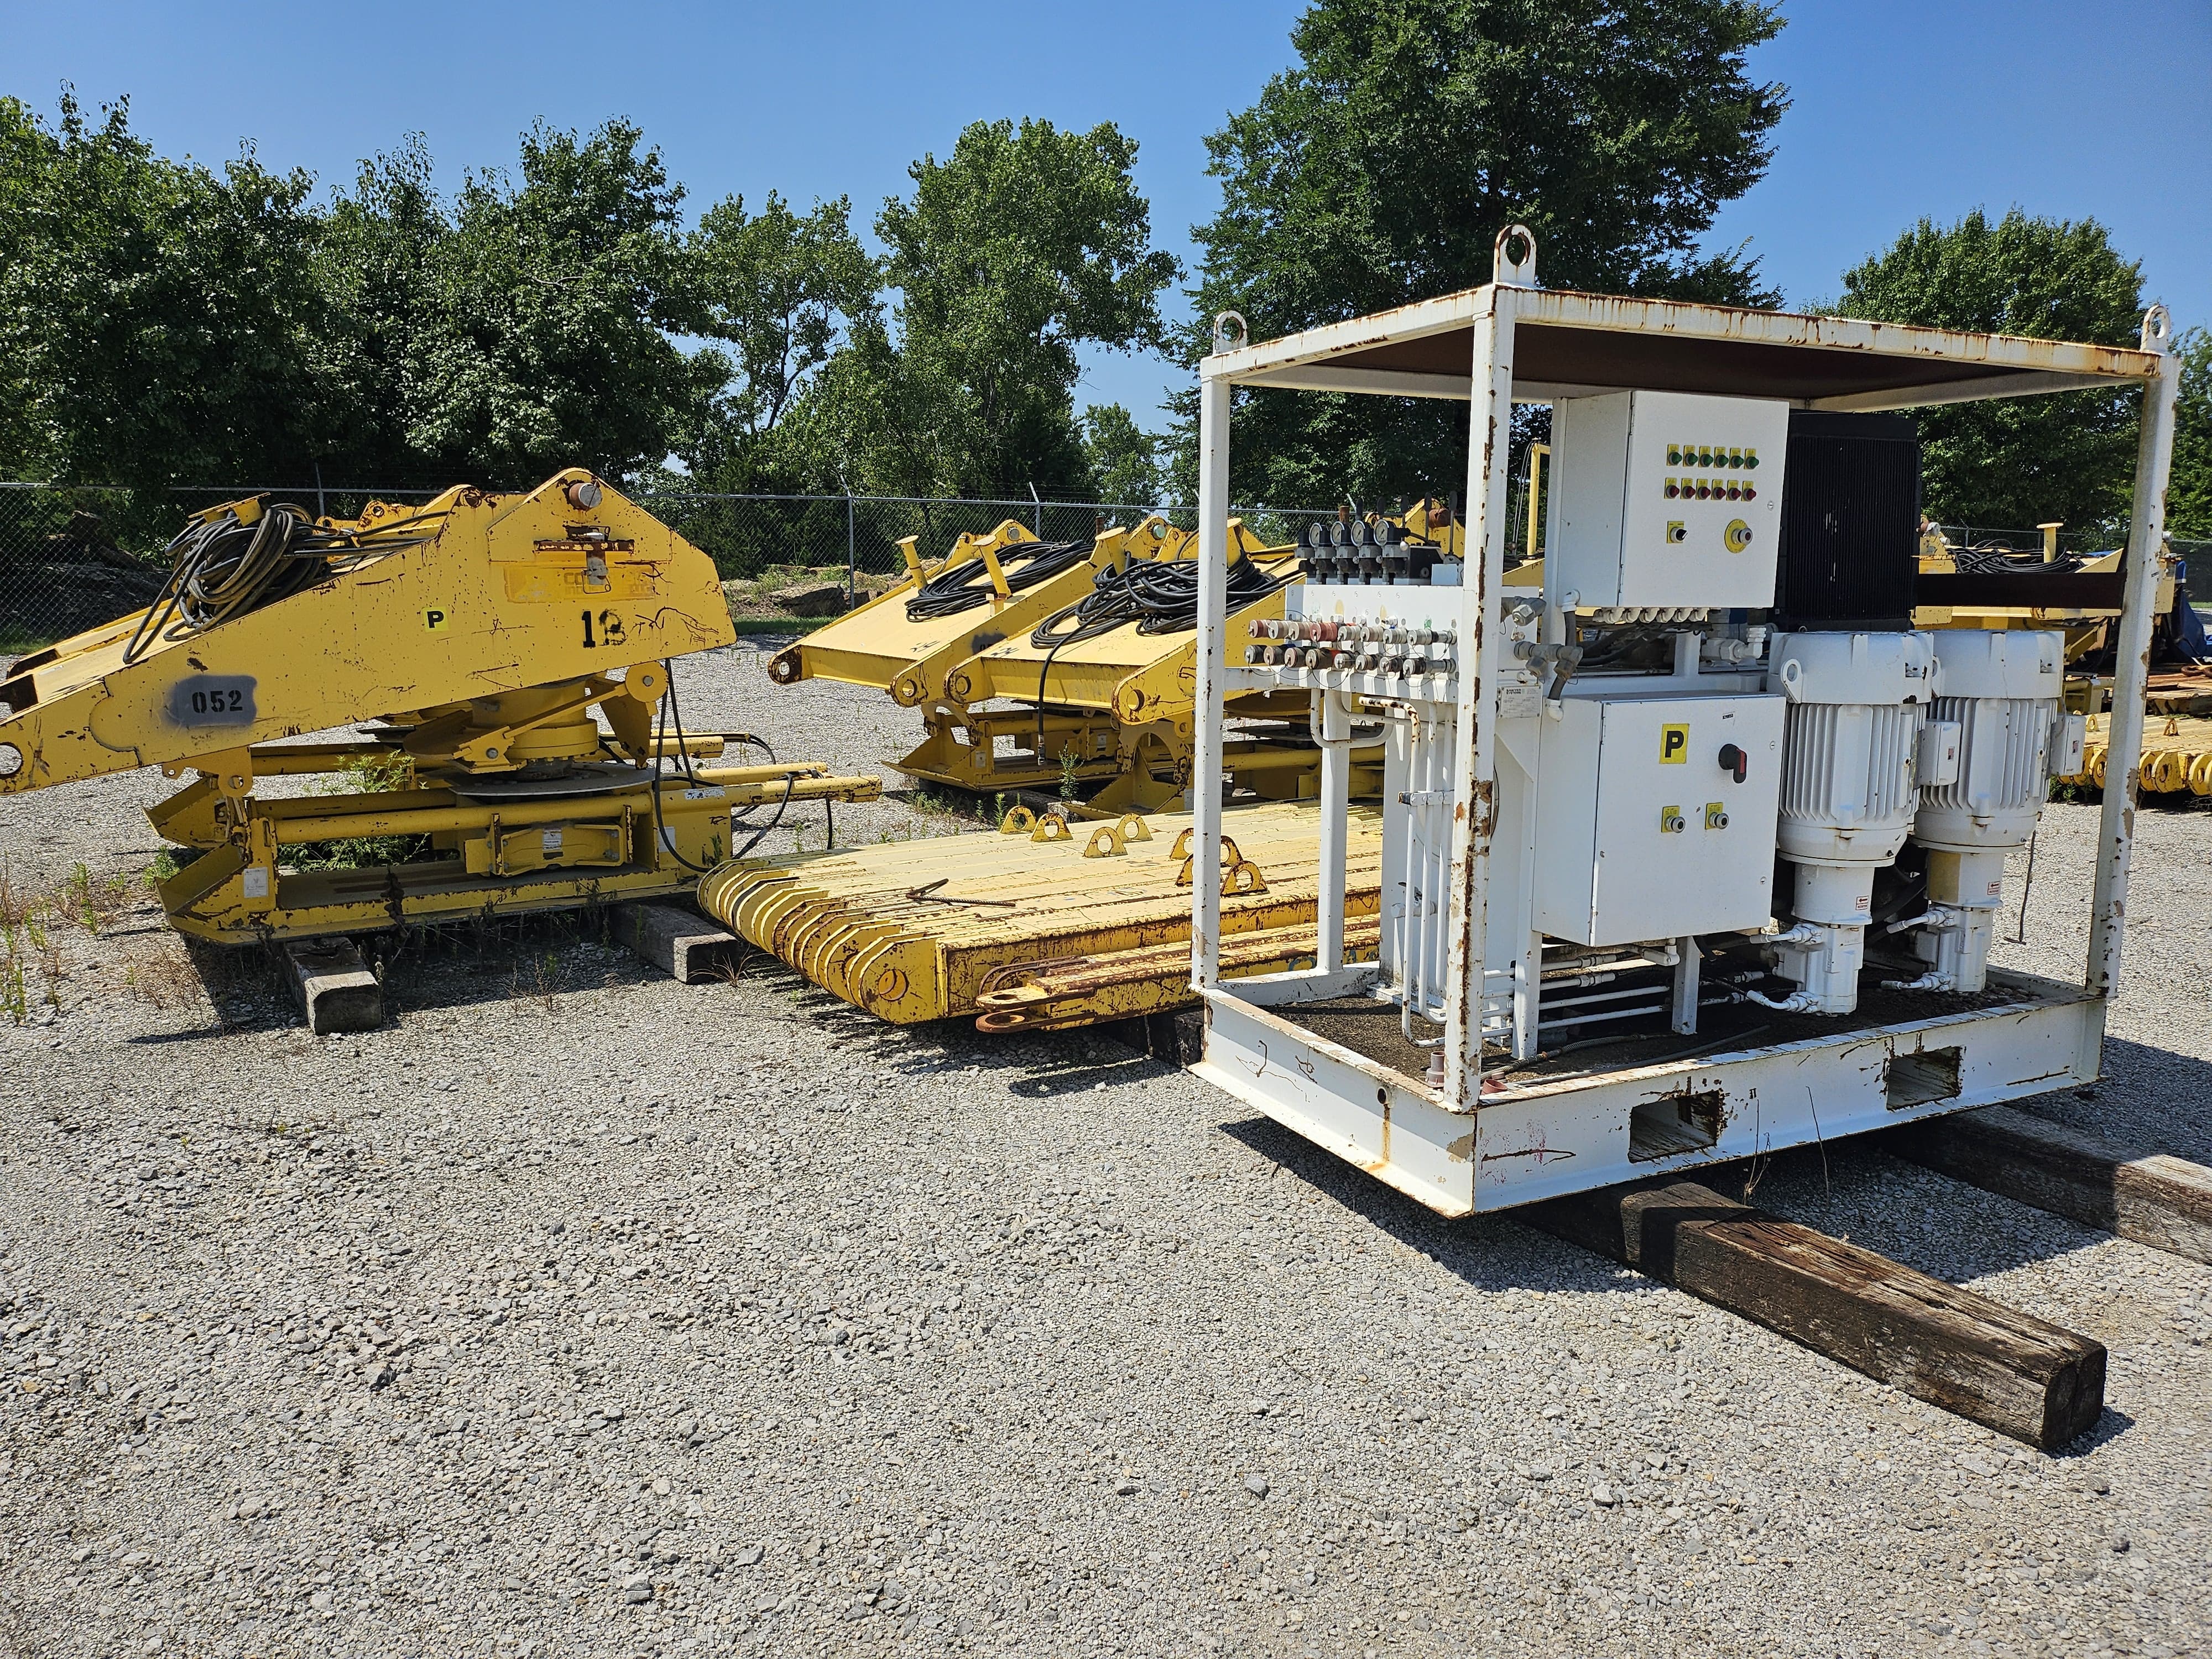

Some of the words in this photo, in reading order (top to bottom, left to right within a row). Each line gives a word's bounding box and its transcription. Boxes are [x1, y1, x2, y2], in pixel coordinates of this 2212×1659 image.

[427, 611, 444, 628] P
[192, 690, 243, 713] 052
[1665, 731, 1684, 758] P
